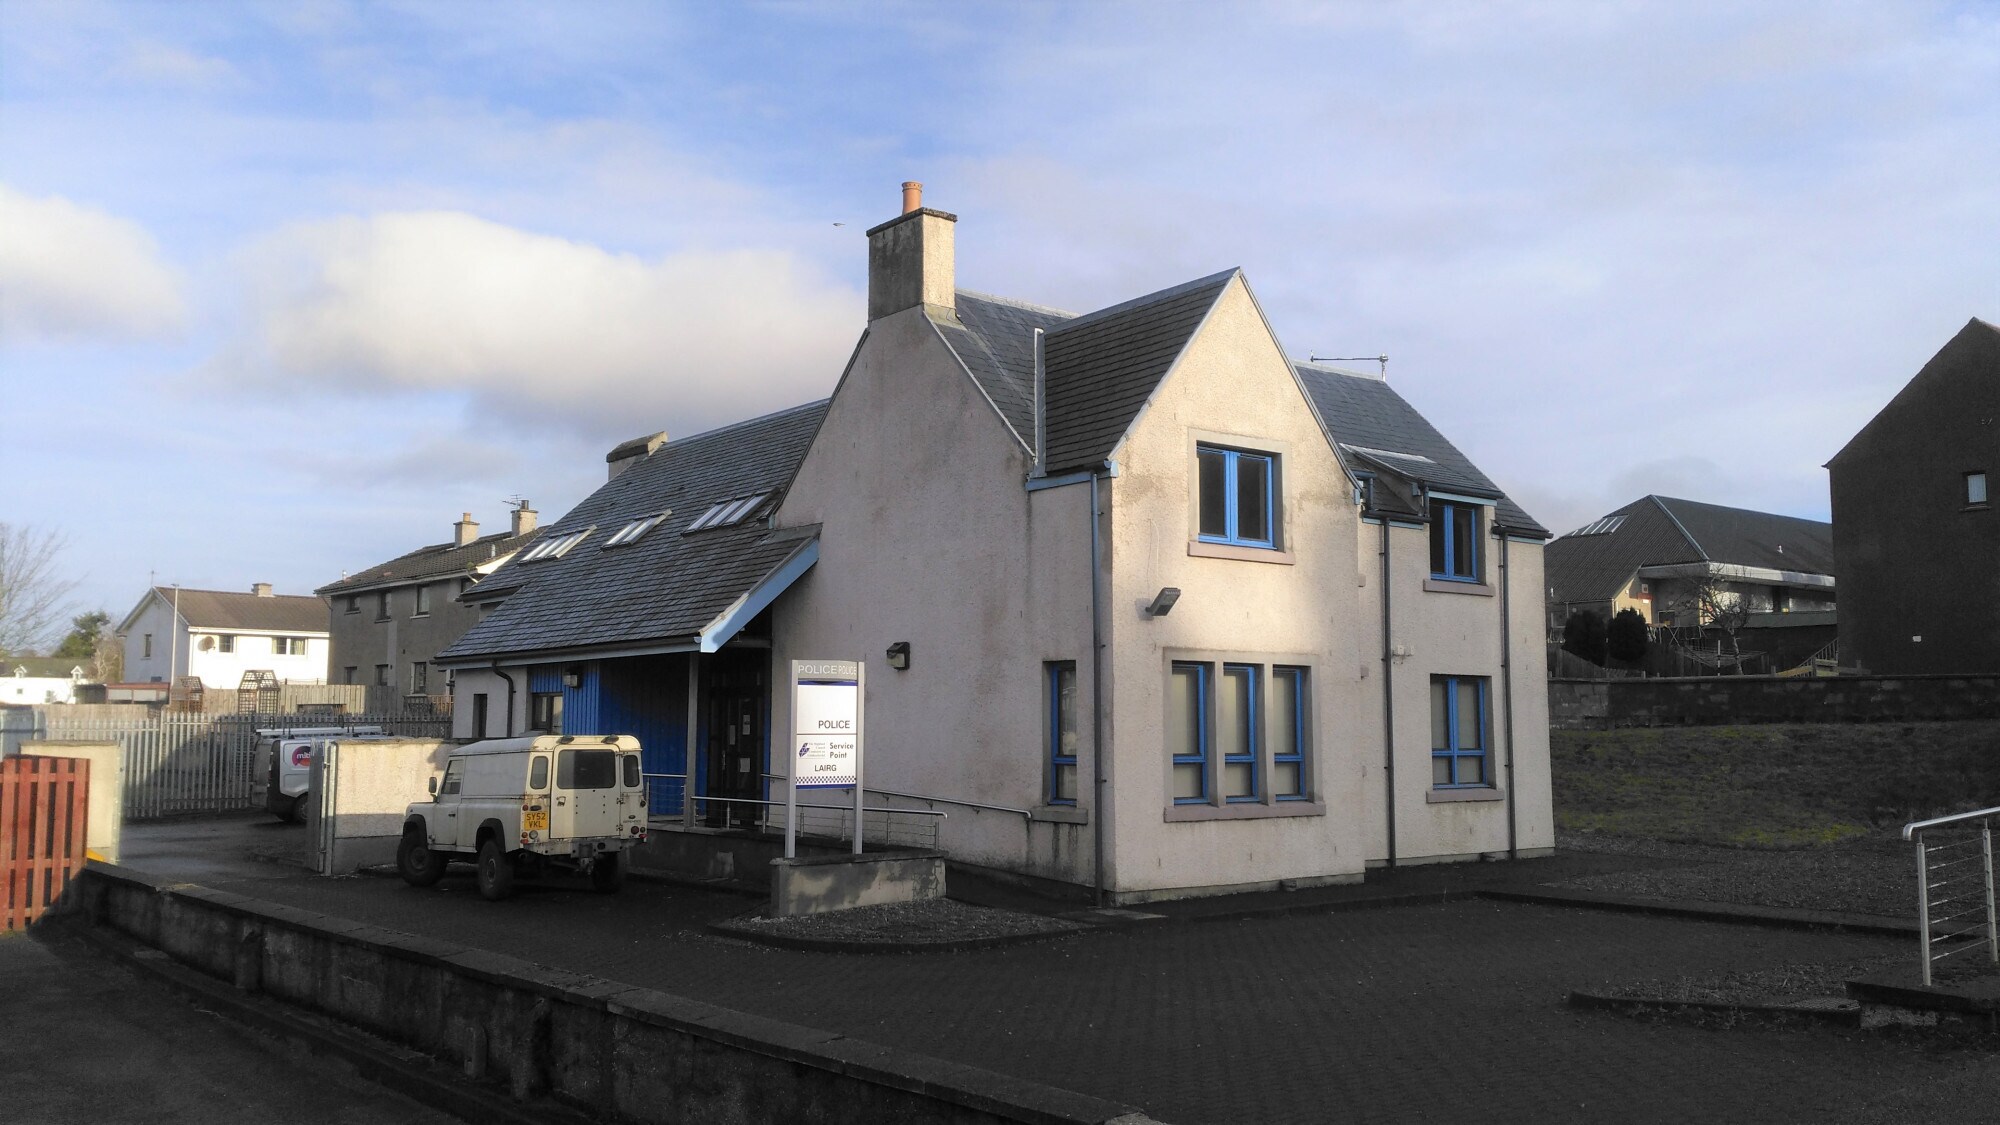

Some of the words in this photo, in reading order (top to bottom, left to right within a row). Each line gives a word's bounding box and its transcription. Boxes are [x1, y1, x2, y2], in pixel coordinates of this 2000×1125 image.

[798, 665, 837, 674] POLICE
[838, 665, 857, 675] POLICE
[818, 720, 850, 729] POLICE
[526, 812, 545, 820] SY52
